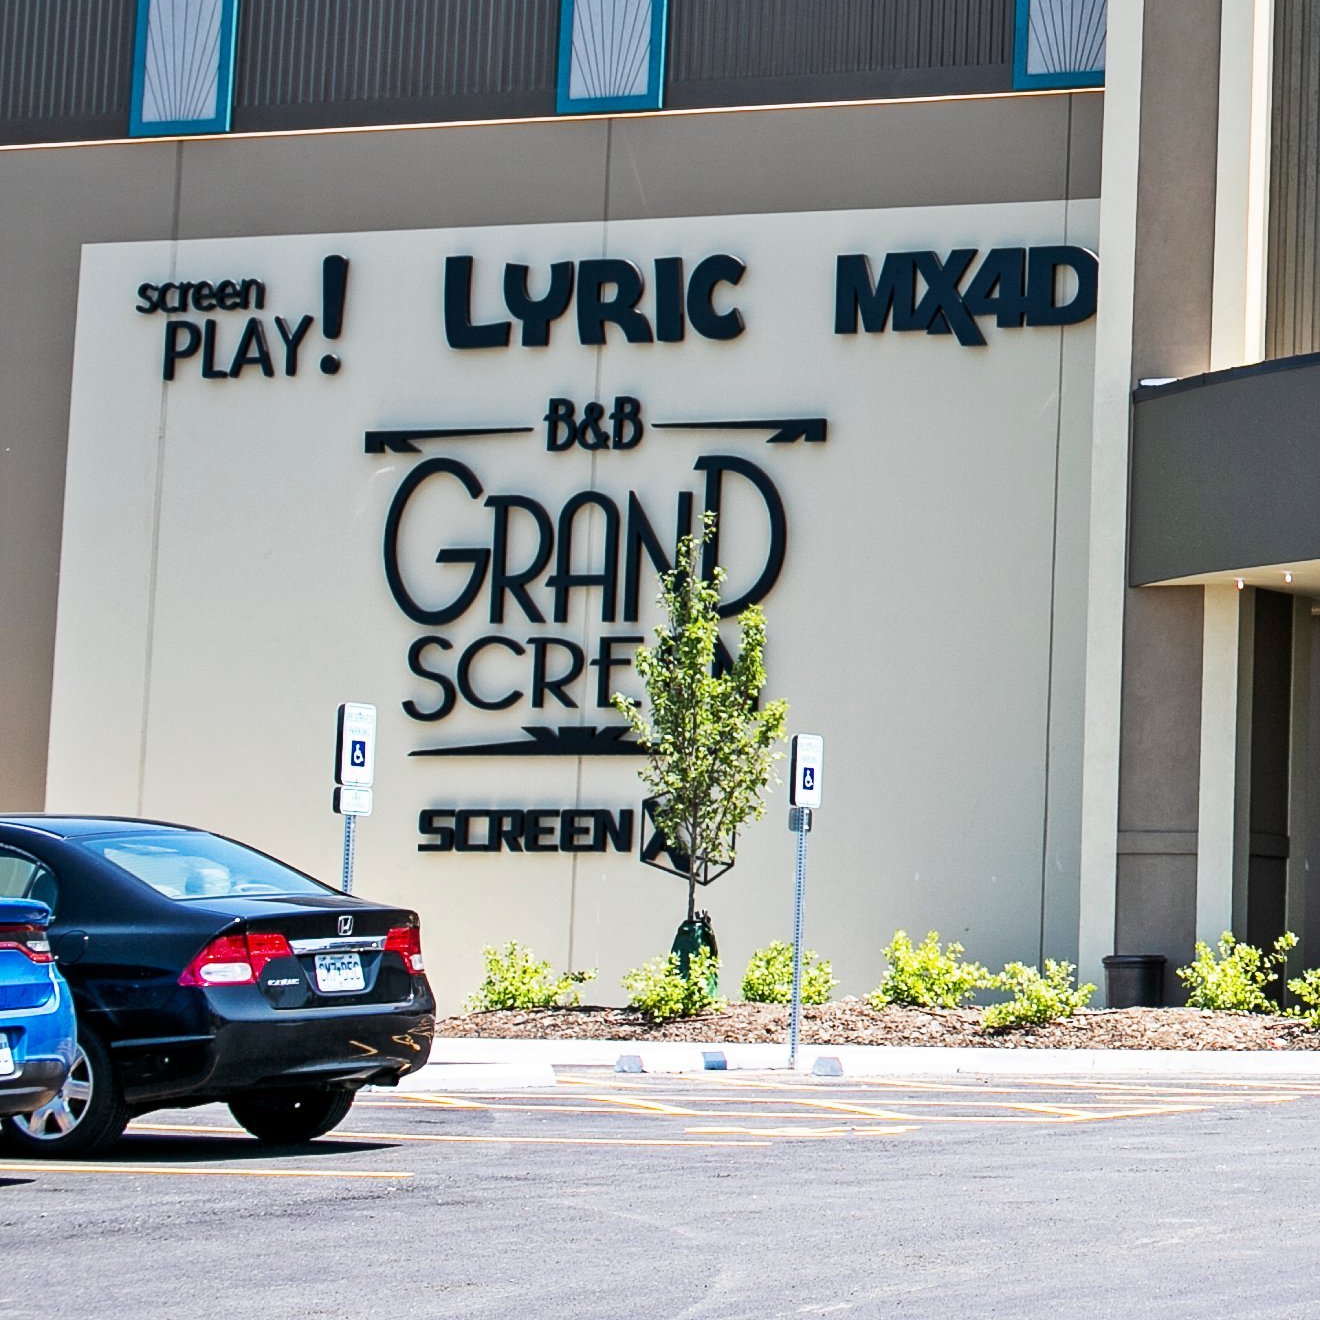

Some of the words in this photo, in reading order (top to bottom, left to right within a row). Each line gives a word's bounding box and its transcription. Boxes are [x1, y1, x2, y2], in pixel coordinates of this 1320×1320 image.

[135, 278, 266, 315] screen
[163, 254, 350, 381] PLAY!
[443, 253, 747, 350] LYRIC
[834, 245, 1100, 347] MX4D
[542, 395, 644, 453] B&B
[383, 454, 788, 626] GRAND
